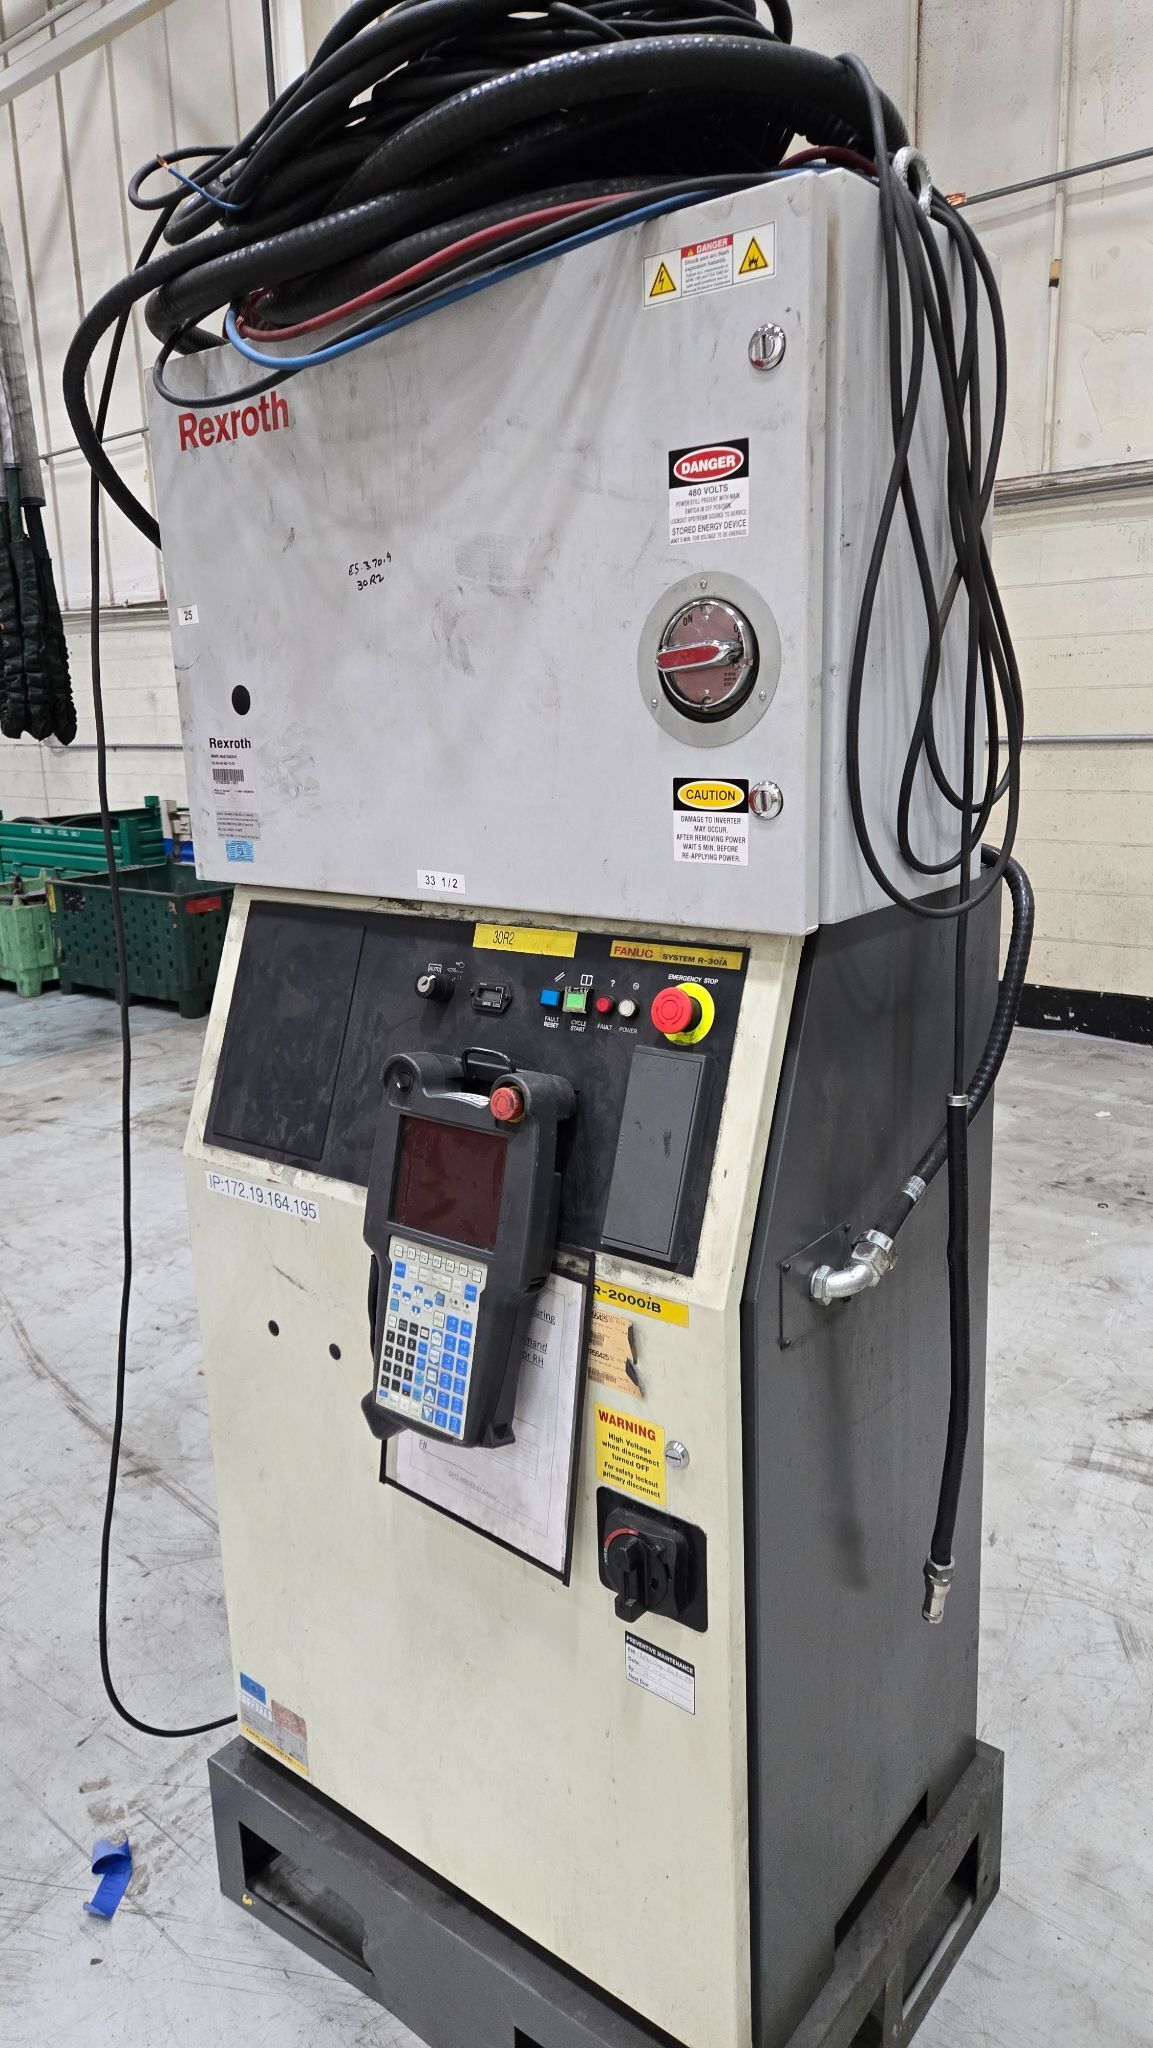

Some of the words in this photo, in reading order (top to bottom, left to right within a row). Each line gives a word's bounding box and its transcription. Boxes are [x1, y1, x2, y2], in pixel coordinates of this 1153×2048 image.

[696, 238, 729, 254] DANGER
[178, 391, 289, 451] Rexroth
[681, 455, 736, 475] DANGER
[688, 488, 701, 497] 480
[703, 484, 729, 495] VOLTS
[672, 526, 696, 536] STORED
[698, 522, 722, 533] ENERGY
[724, 519, 747, 529] DEVICE
[357, 574, 385, 591] 30R2
[184, 610, 193, 621] 25
[682, 614, 693, 626] ON
[209, 738, 251, 749] Rexroth
[686, 789, 736, 801] CAUTION
[680, 816, 704, 824] DAMAGE
[705, 816, 712, 824] TO
[714, 817, 741, 825] INVERTER
[694, 825, 706, 833] MAY
[707, 826, 729, 834] OCCUR.
[694, 834, 724, 843] REMOVING
[725, 836, 746, 844] POWER
[702, 844, 716, 852] MIN.
[716, 844, 738, 853] BEFORE
[682, 852, 718, 861] RE-APPLYING
[718, 854, 741, 862] POWER.
[424, 875, 436, 886] 33
[442, 877, 458, 889] 1/2
[492, 930, 515, 945] 30R2
[614, 946, 654, 958] FANUC
[662, 953, 695, 963] SYSTEM
[668, 974, 702, 983] EMERGENCY
[704, 977, 720, 985] STOP
[596, 1023, 613, 1031] FAULT
[618, 1026, 638, 1034] POWER
[209, 1174, 317, 1220] IP:172.19.164.195
[593, 1284, 661, 1313] R-2000iB
[532, 1354, 544, 1367] RH
[598, 1409, 656, 1442] WARNING
[608, 1432, 624, 1444] High
[626, 1440, 652, 1455] Voltage
[602, 1440, 620, 1452] when
[622, 1448, 660, 1467] disconnect
[612, 1453, 634, 1466] turned
[636, 1462, 650, 1472] OFF
[604, 1461, 614, 1470] For
[616, 1466, 634, 1479] safety
[635, 1474, 658, 1488] lockout
[602, 1470, 626, 1484] primary
[626, 1480, 660, 1499] disconnect
[626, 1635, 656, 1655] PREVENTIVE
[656, 1650, 694, 1675] MAINTENANCE
